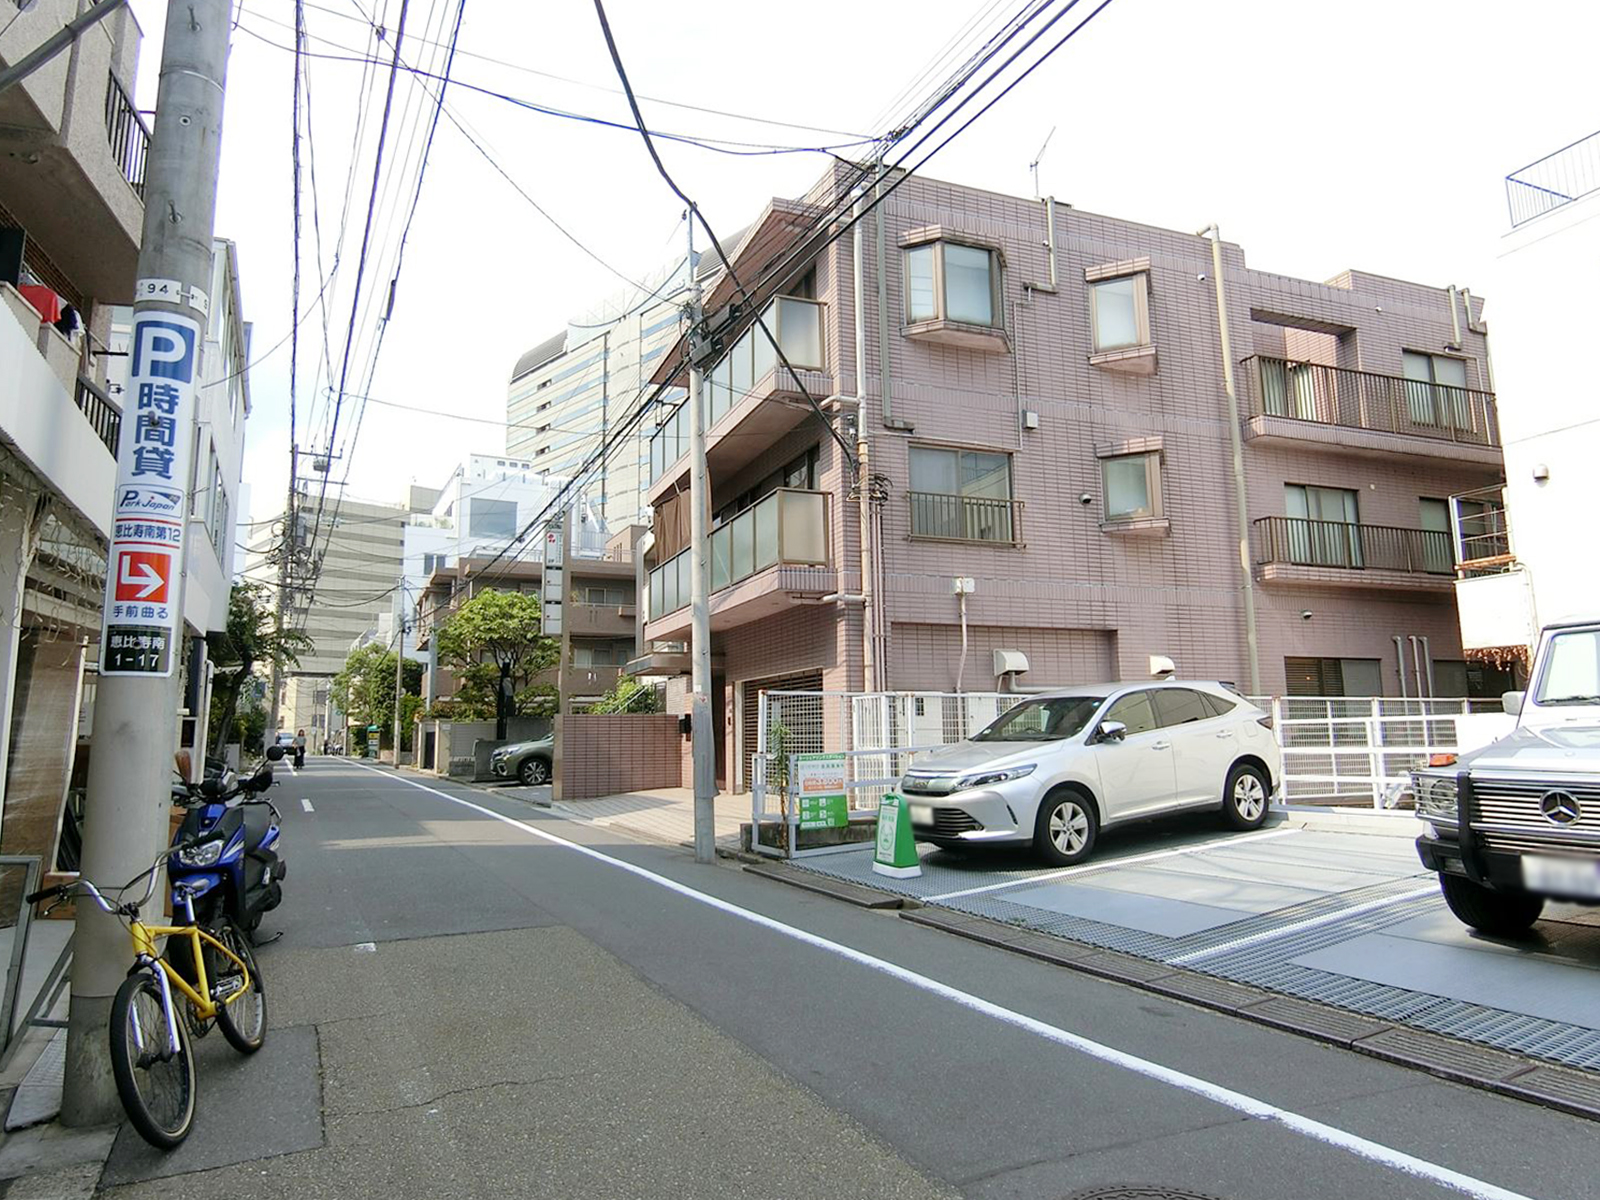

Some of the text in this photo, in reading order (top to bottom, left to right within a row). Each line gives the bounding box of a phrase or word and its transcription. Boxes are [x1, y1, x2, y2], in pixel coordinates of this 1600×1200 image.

[147, 283, 170, 295] 94
[139, 326, 186, 379] P
[131, 382, 180, 480] 時間貸
[113, 605, 169, 620] 手前曲る
[110, 635, 166, 651] 恵比寿南
[114, 653, 160, 667] 1-17
